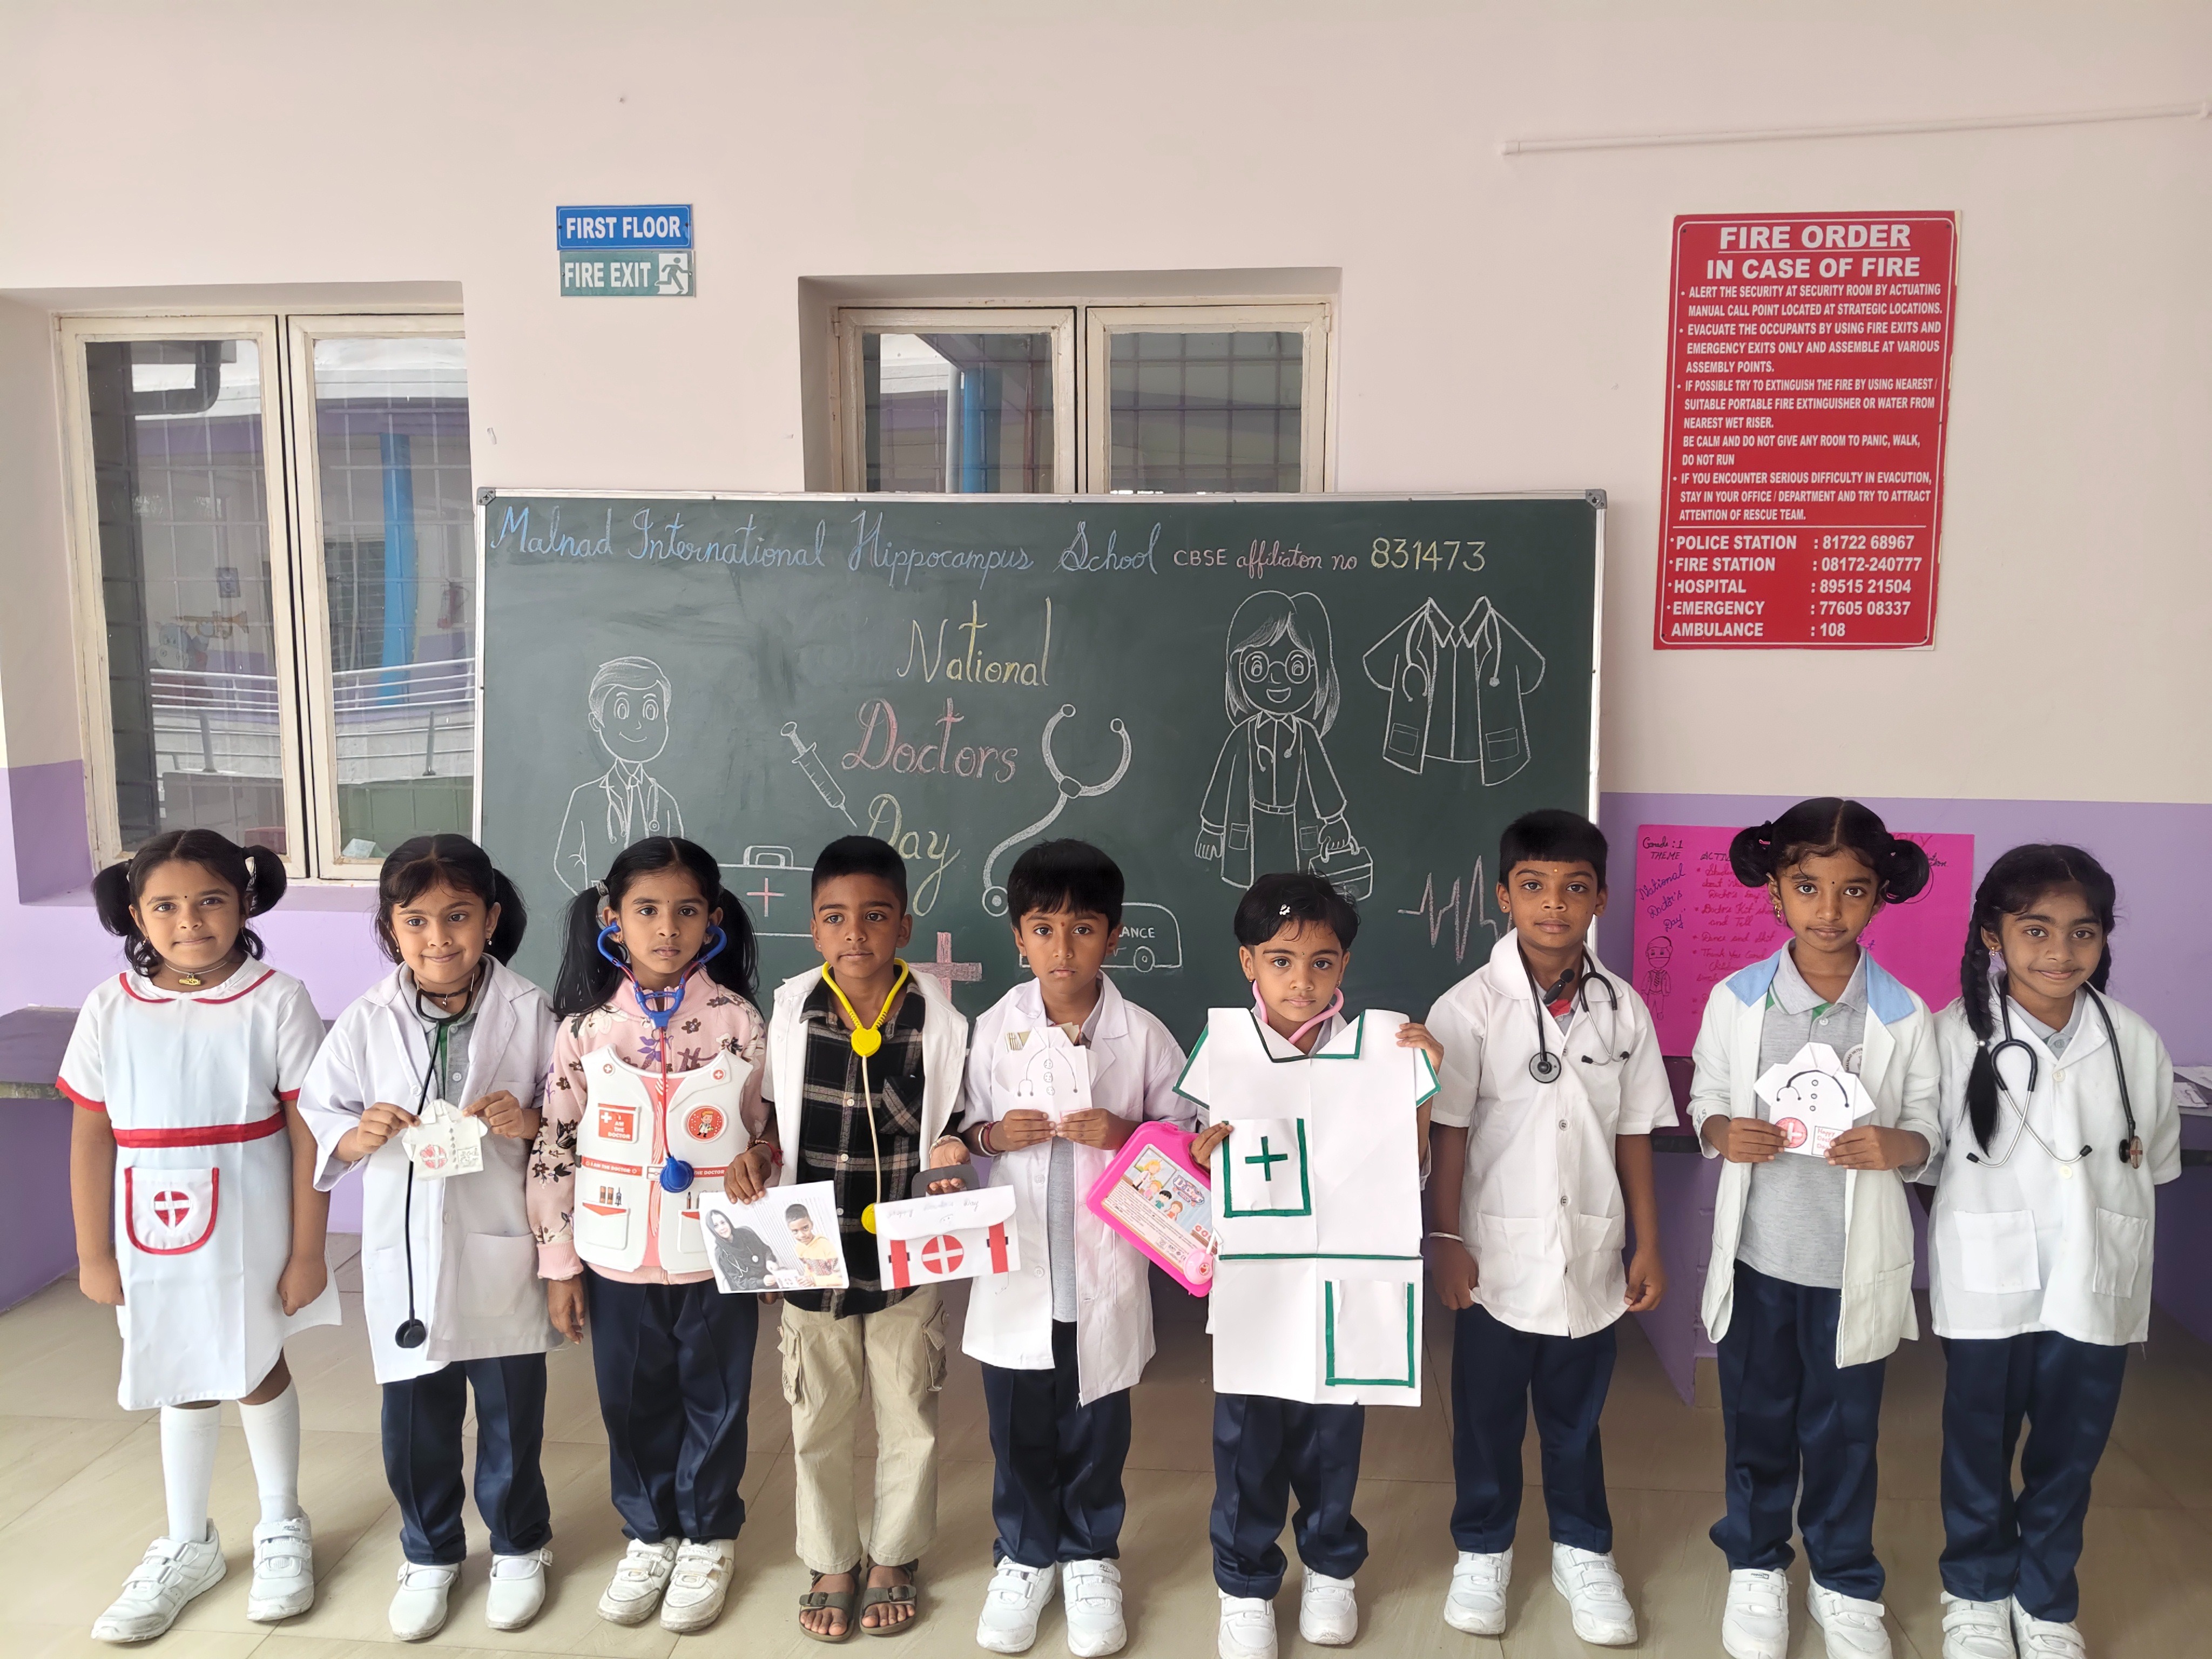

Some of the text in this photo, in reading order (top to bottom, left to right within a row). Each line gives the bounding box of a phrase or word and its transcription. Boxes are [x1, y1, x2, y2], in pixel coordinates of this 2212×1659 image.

[567, 216, 681, 239] FIRST FLOOR
[1719, 224, 1910, 249] FIRE ORDER
[564, 262, 651, 288] FIRE EXIT
[1707, 257, 1920, 279] IN CASE OF FIRE
[1689, 283, 1941, 298] ALERT THE SECURITY AT SECURITY ROOM BY ACTUATING
[1688, 302, 1943, 317] MANUAL CALL POINT LOCATED AT STRATEGIC LOCATIONS.
[1688, 321, 1941, 335] EVACUATE THE OCCUPANTS BY USING FIRE EXITS AND
[1686, 340, 1940, 354] EMERGENCY EXITS ONLY AND ASSEMBLE AT VARIOUS
[1685, 360, 1775, 373] ASSEMBLY POINTS.
[1684, 377, 1933, 392] IF POSSIBLE TRY TO EXTINGUISH THE FIRE BY USING NEAREST
[1684, 396, 1935, 410] SUITABLE PORTABLE FIRE EXTINGUISHER OR WATER FROM
[1683, 416, 1774, 429] NEAREST WET RISER.
[1683, 434, 1920, 448] BE CALM AND DO NOT GIVE ANY ROOM TO PANIC, WALK,
[1682, 454, 1735, 466] DO NOT RUN
[1681, 471, 1932, 485] IF YOU ENCOUNTER SERIOUS DIFFICULTY IN EVACUTION,
[1680, 491, 1702, 503] STAY
[1704, 491, 1714, 502] IN
[1715, 491, 1739, 503] YOUR
[1741, 490, 1772, 502] OFFICE
[1778, 490, 1836, 502] DEPARTMENT
[1837, 490, 1856, 502] AND
[1858, 490, 1876, 502] TRY
[1877, 490, 1889, 502] TO
[1891, 490, 1931, 502] ATTRACT
[1679, 509, 1806, 521] ATTENTION OF RESCUE TEAM.
[490, 506, 612, 556] Malnad
[628, 506, 826, 568] International
[848, 510, 1034, 590] Hippocampus
[1053, 521, 1162, 575] School
[1173, 549, 1228, 566] CBSE
[1332, 552, 1357, 571] no
[1370, 537, 1487, 572] 831473
[1676, 535, 1915, 550] POLICE STATION 81722 68967
[1675, 557, 1922, 572] FIRE STATION 08172-240777
[1674, 578, 1912, 594] HOSPITAL 89515 21504
[1673, 601, 1911, 616] EMERGENCY 77605 08337
[1671, 622, 1845, 637] AMBULANCE 108
[896, 596, 1052, 686] National
[841, 696, 1018, 783] Doctors
[867, 793, 961, 917] Day
[1650, 851, 1682, 860] THEME
[1647, 890, 1683, 919] Doctor's
[1709, 915, 1728, 926] and
[1119, 926, 1156, 939] ANCE
[1731, 932, 1750, 943] and
[1701, 948, 1724, 958] Thank
[608, 1131, 631, 1139] DOCTOR
[610, 1165, 631, 1174] DOCTOR
